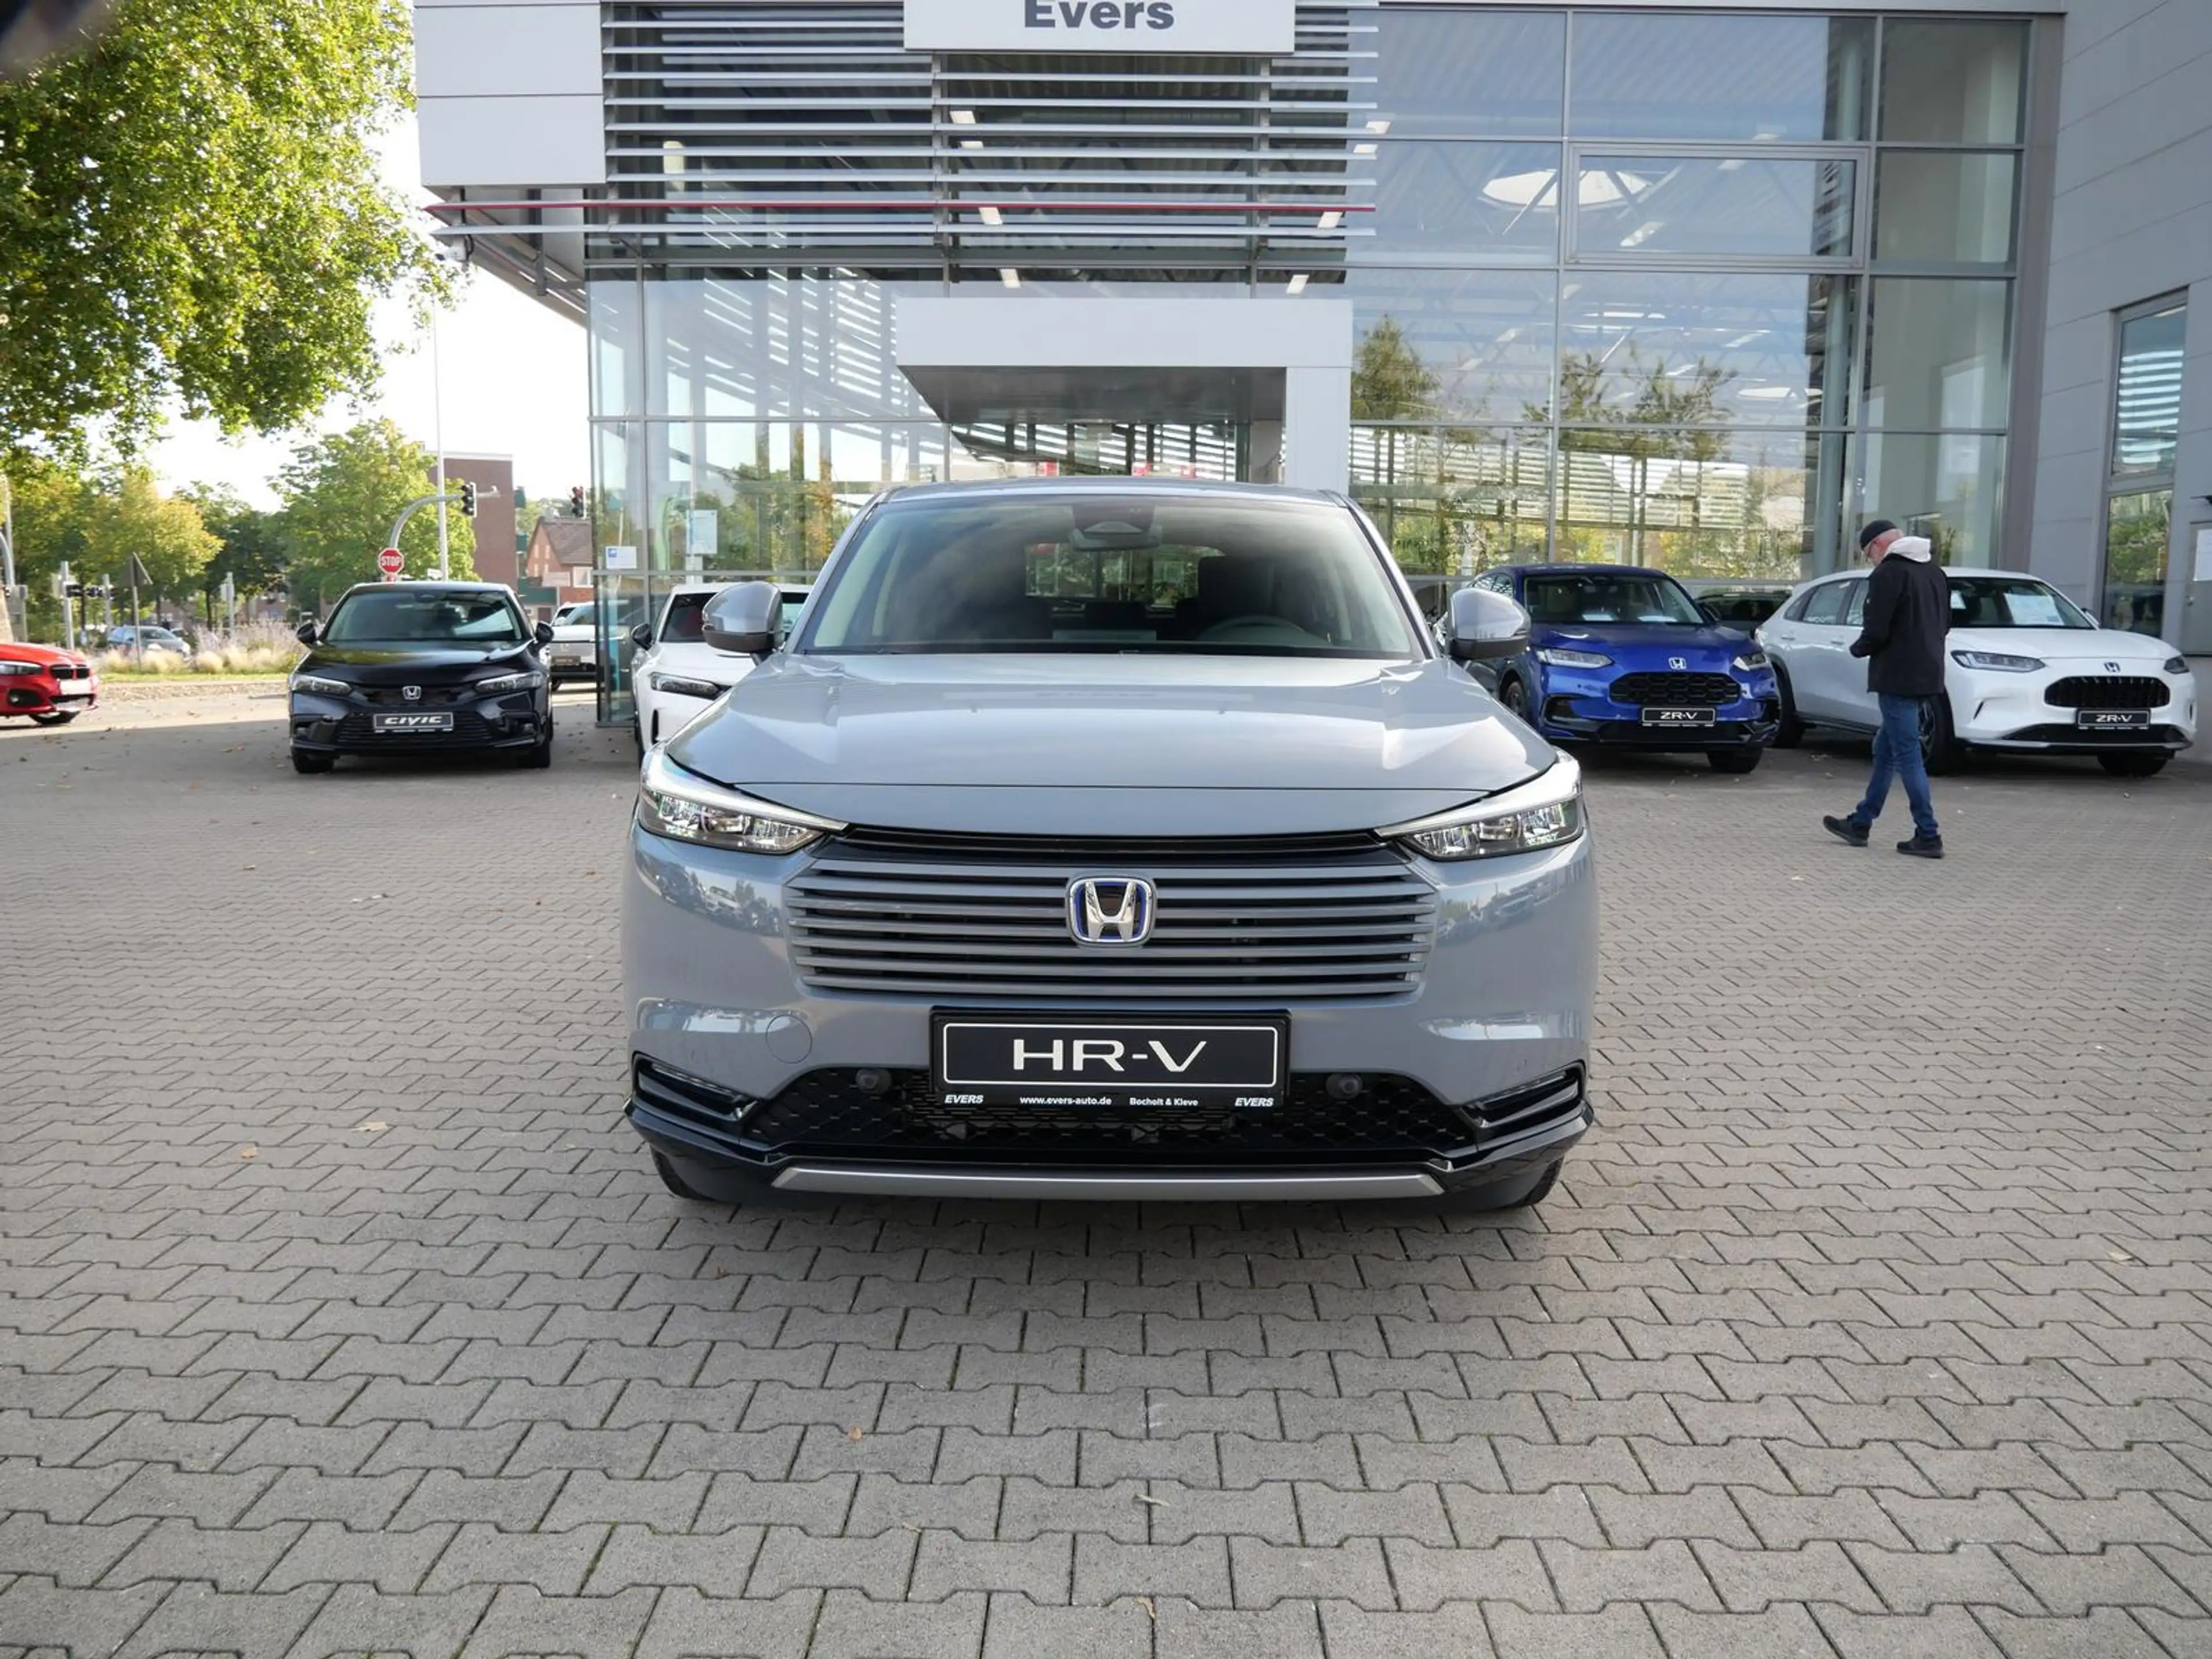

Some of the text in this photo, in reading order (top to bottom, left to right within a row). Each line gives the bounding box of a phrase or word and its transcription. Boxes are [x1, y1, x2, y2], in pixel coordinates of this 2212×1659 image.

[1025, 0, 1174, 29] Evers
[381, 556, 402, 566] STOP
[1660, 711, 1698, 719] ZR-V
[385, 716, 442, 726] CIVIC
[1013, 1039, 1206, 1071] HR-V
[945, 1094, 984, 1104] EVERS
[1020, 1096, 1112, 1105] www.evers-auto.de
[1165, 1097, 1172, 1105] &
[1234, 1097, 1274, 1107] EVERS
